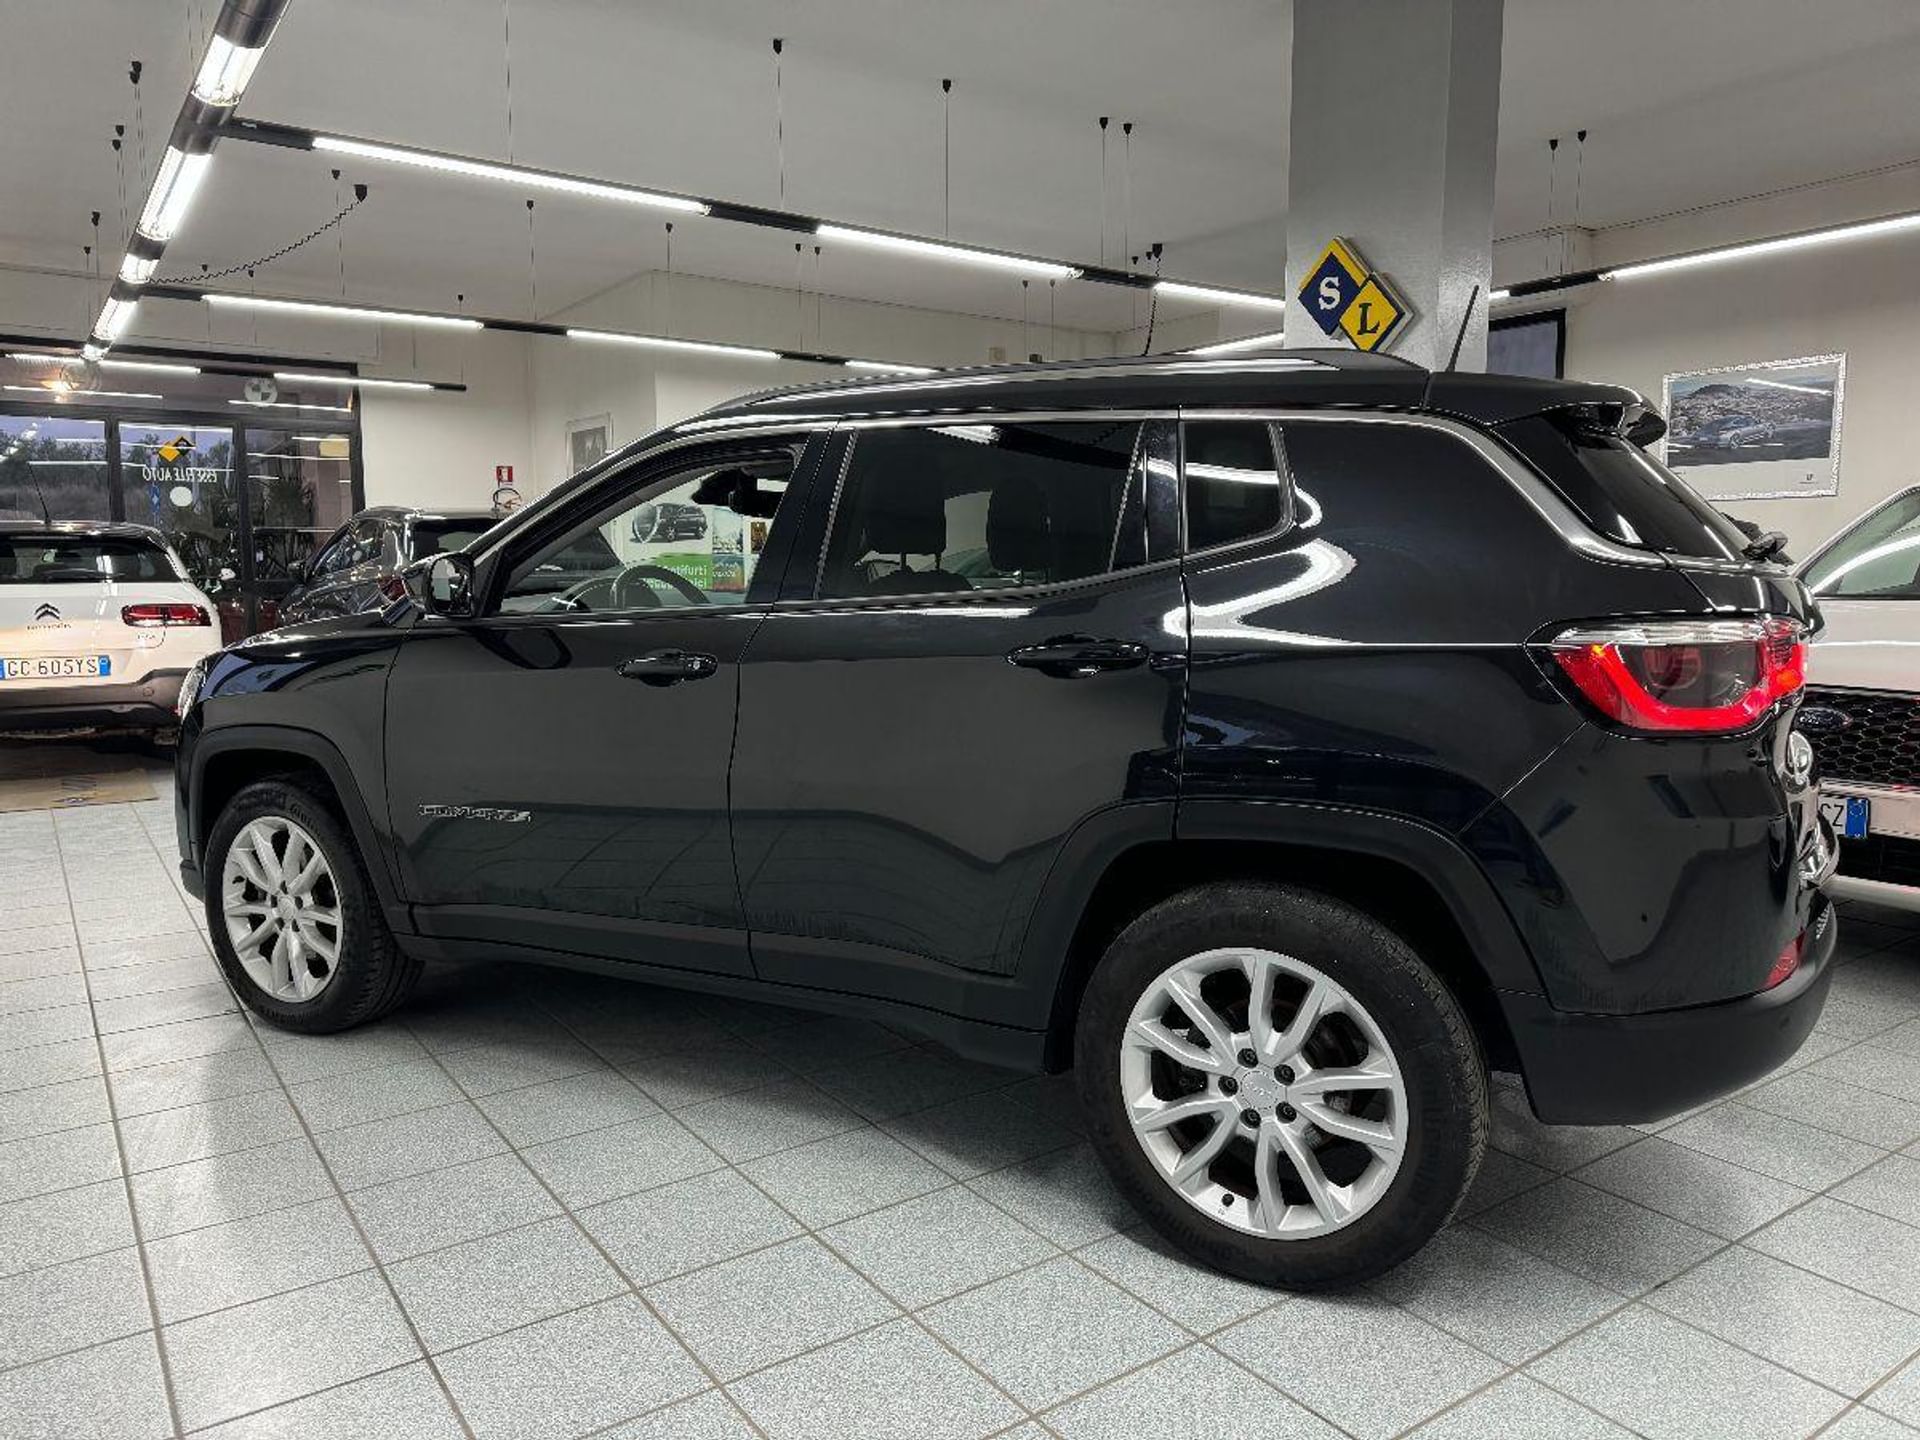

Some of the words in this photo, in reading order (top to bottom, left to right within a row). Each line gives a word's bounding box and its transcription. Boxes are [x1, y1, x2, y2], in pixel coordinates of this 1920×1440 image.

[1318, 276, 1341, 310] S
[1357, 302, 1381, 336] L
[7, 660, 31, 677] GC
[37, 659, 98, 675] 605YS
